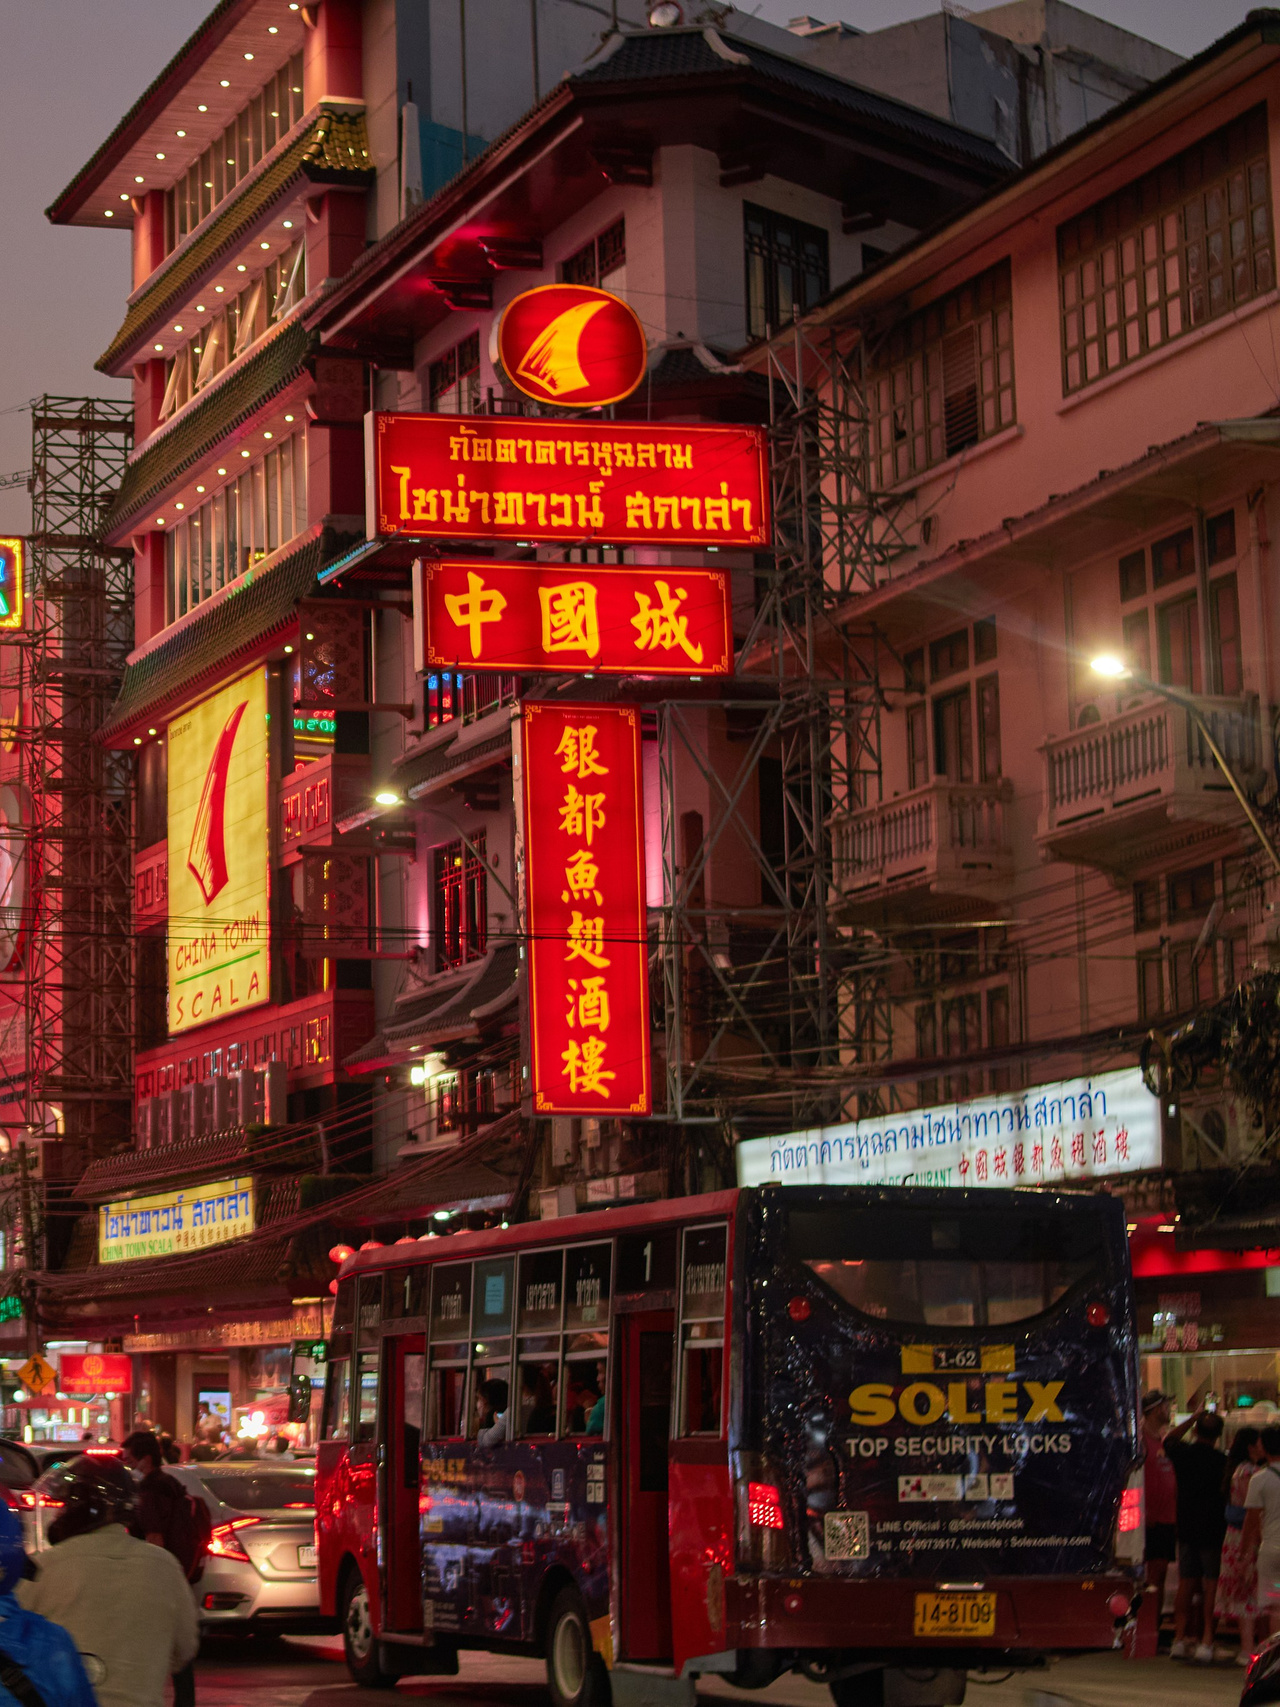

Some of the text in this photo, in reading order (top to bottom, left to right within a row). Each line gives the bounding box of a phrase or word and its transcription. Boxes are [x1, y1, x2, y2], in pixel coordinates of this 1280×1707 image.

[449, 425, 694, 476] ภัตตาคารหูฉลาม
[390, 465, 753, 531] ไชน่าทาวน์ สกาล่า
[444, 571, 704, 665] 中國城
[554, 724, 616, 1099] 銀都魚翅酒樓
[175, 911, 260, 971] CHINA TOWN
[175, 971, 260, 1026] SCALA
[102, 1238, 173, 1261] CHINA TOWN SCALA
[643, 1241, 652, 1282] 1
[404, 1274, 411, 1309] 1
[938, 1351, 977, 1367] 1-62
[848, 1381, 1066, 1427] SOLEX
[846, 1433, 1072, 1458] TOP SECURITY LOCKS
[876, 1521, 901, 1533] LINE
[903, 1520, 940, 1532] Official
[961, 1538, 1003, 1549] Website
[922, 1603, 990, 1623] 14-8109
